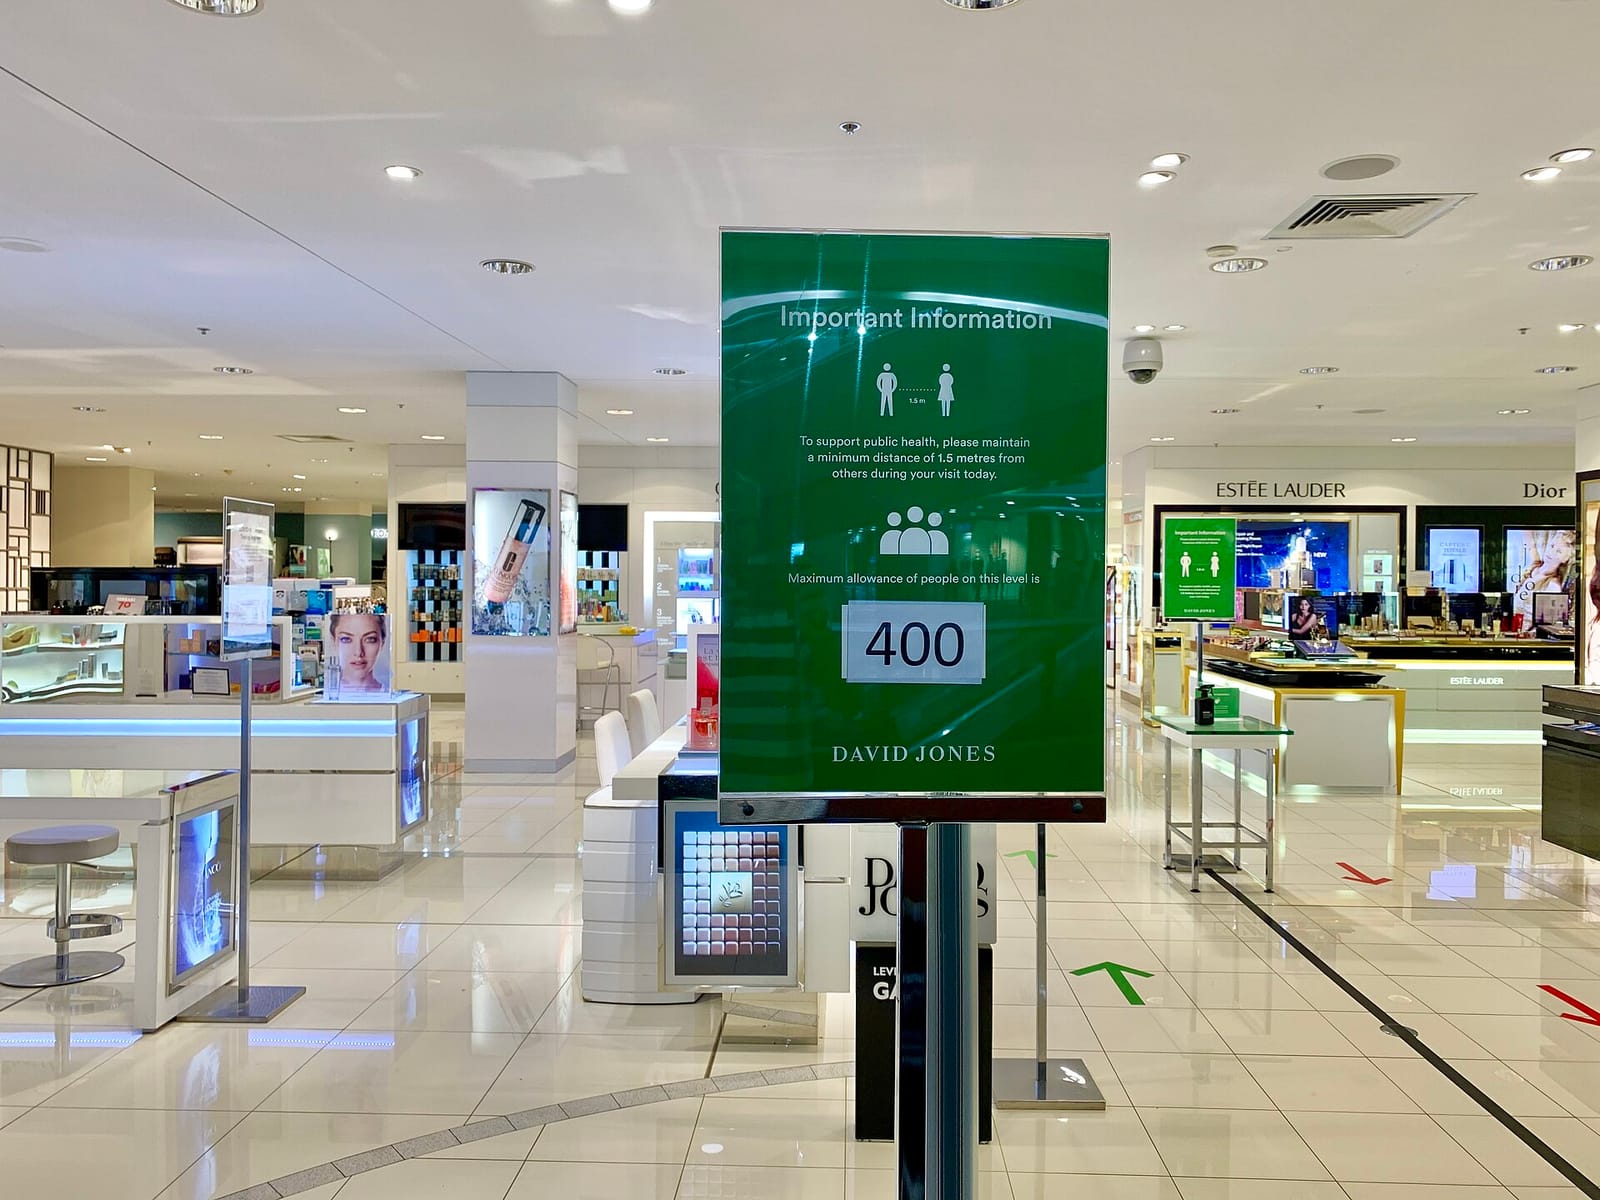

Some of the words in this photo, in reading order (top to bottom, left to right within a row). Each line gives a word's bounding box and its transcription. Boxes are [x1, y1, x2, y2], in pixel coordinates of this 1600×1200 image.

[780, 305, 903, 329] Important
[911, 307, 1053, 330] Information
[800, 435, 814, 447] To
[816, 437, 860, 450] support
[863, 435, 898, 449] public
[901, 435, 940, 449] health,
[943, 436, 979, 450] please
[982, 436, 1030, 448] maintain
[808, 454, 814, 463] a
[818, 452, 870, 463] minimum
[873, 452, 920, 463] distance
[923, 452, 935, 463] of
[938, 453, 953, 463] 1.5
[956, 453, 995, 464] metres
[998, 452, 1025, 464] from
[832, 468, 868, 479] others
[870, 468, 907, 481] during
[910, 470, 935, 481] your
[938, 468, 961, 479] visit
[963, 468, 997, 481] today.
[1274, 482, 1346, 498] LAUDER
[1523, 482, 1567, 499] Dior
[788, 573, 844, 584] Maximum
[847, 573, 903, 584] allowance
[906, 573, 918, 584] of
[921, 574, 958, 587] people
[962, 575, 976, 584] on
[979, 573, 1000, 584] this
[1003, 573, 1028, 584] level
[1031, 573, 1040, 584] is
[865, 621, 964, 667] 400
[1473, 677, 1504, 685] LAUDER
[832, 746, 908, 763] DAVID
[915, 746, 996, 763] JONES
